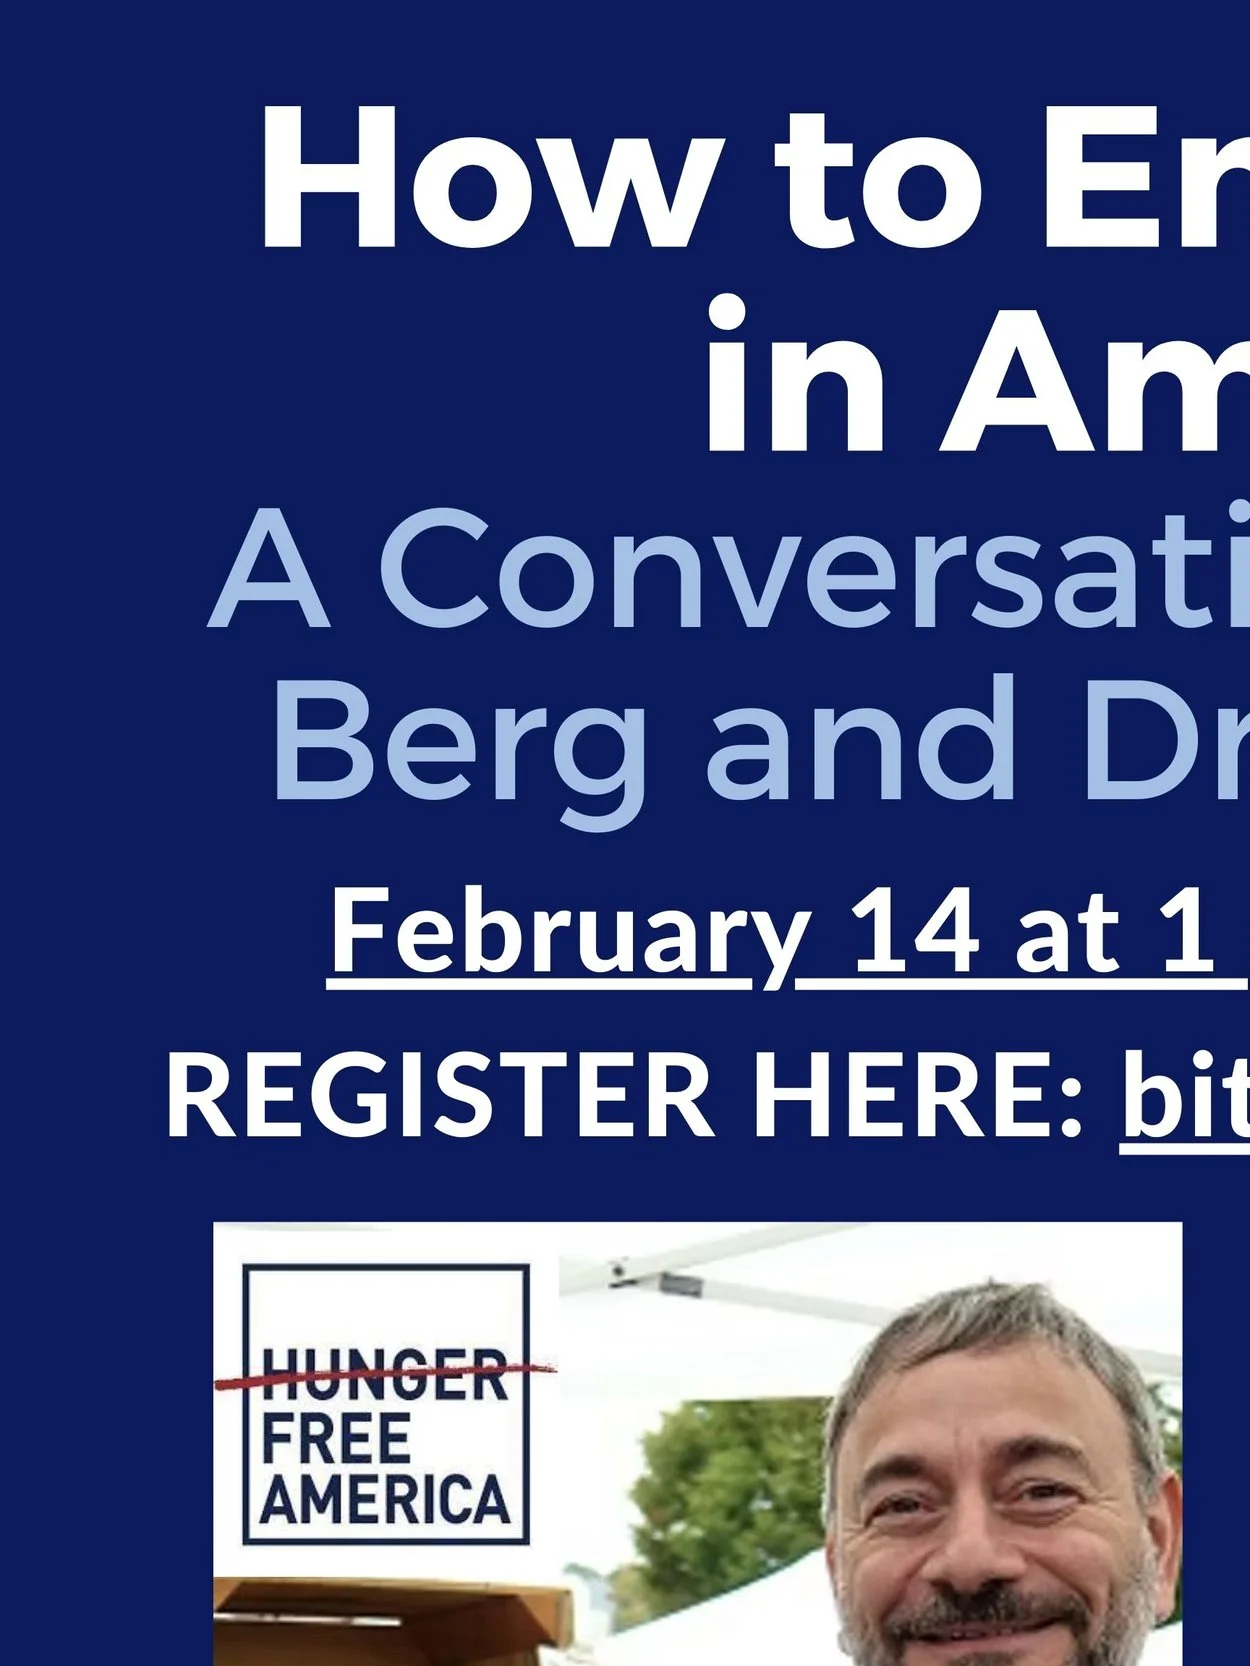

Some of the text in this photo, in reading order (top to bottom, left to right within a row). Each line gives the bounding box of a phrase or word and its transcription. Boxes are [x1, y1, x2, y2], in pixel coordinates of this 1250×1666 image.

[265, 106, 726, 248] How
[774, 113, 982, 249] to
[709, 293, 883, 451] in
[206, 508, 331, 627] A
[277, 680, 644, 833] Berg
[707, 673, 1013, 800] and
[335, 885, 812, 991] February
[852, 887, 979, 972] 14
[1017, 894, 1120, 973] at
[1160, 887, 1214, 972] 1
[169, 1052, 715, 1138] REGISTER
[758, 1052, 1083, 1138] HERE:
[262, 1348, 510, 1401] HUNGER
[263, 1412, 410, 1464] FREE
[259, 1475, 511, 1524] AMERICA
